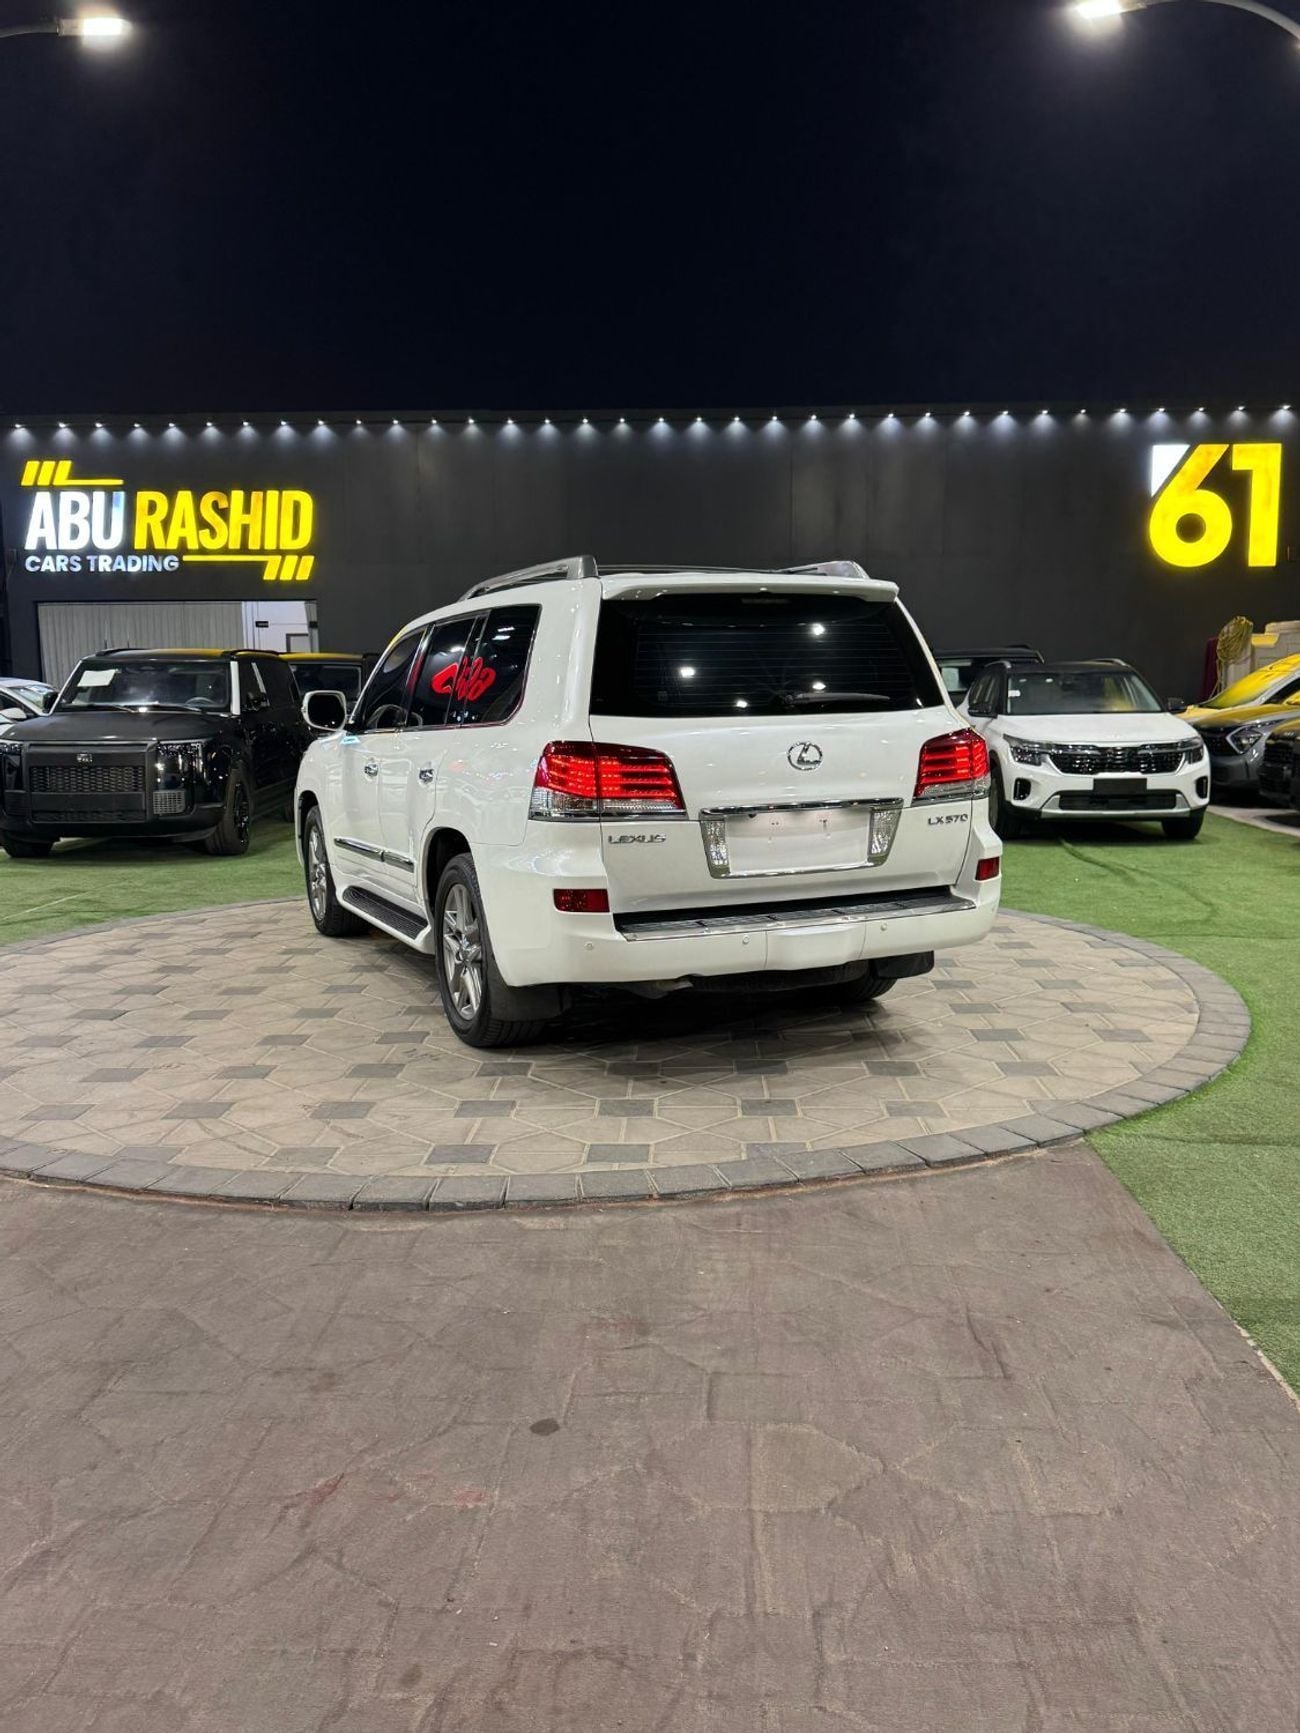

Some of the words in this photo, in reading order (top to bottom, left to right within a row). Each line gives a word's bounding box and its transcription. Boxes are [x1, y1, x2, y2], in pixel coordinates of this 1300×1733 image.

[25, 491, 125, 550] ABU
[134, 490, 313, 550] RASHID
[1149, 443, 1282, 568] 61
[25, 555, 82, 572] CARS
[87, 555, 180, 572] TRADING
[607, 834, 667, 845] LEXUS
